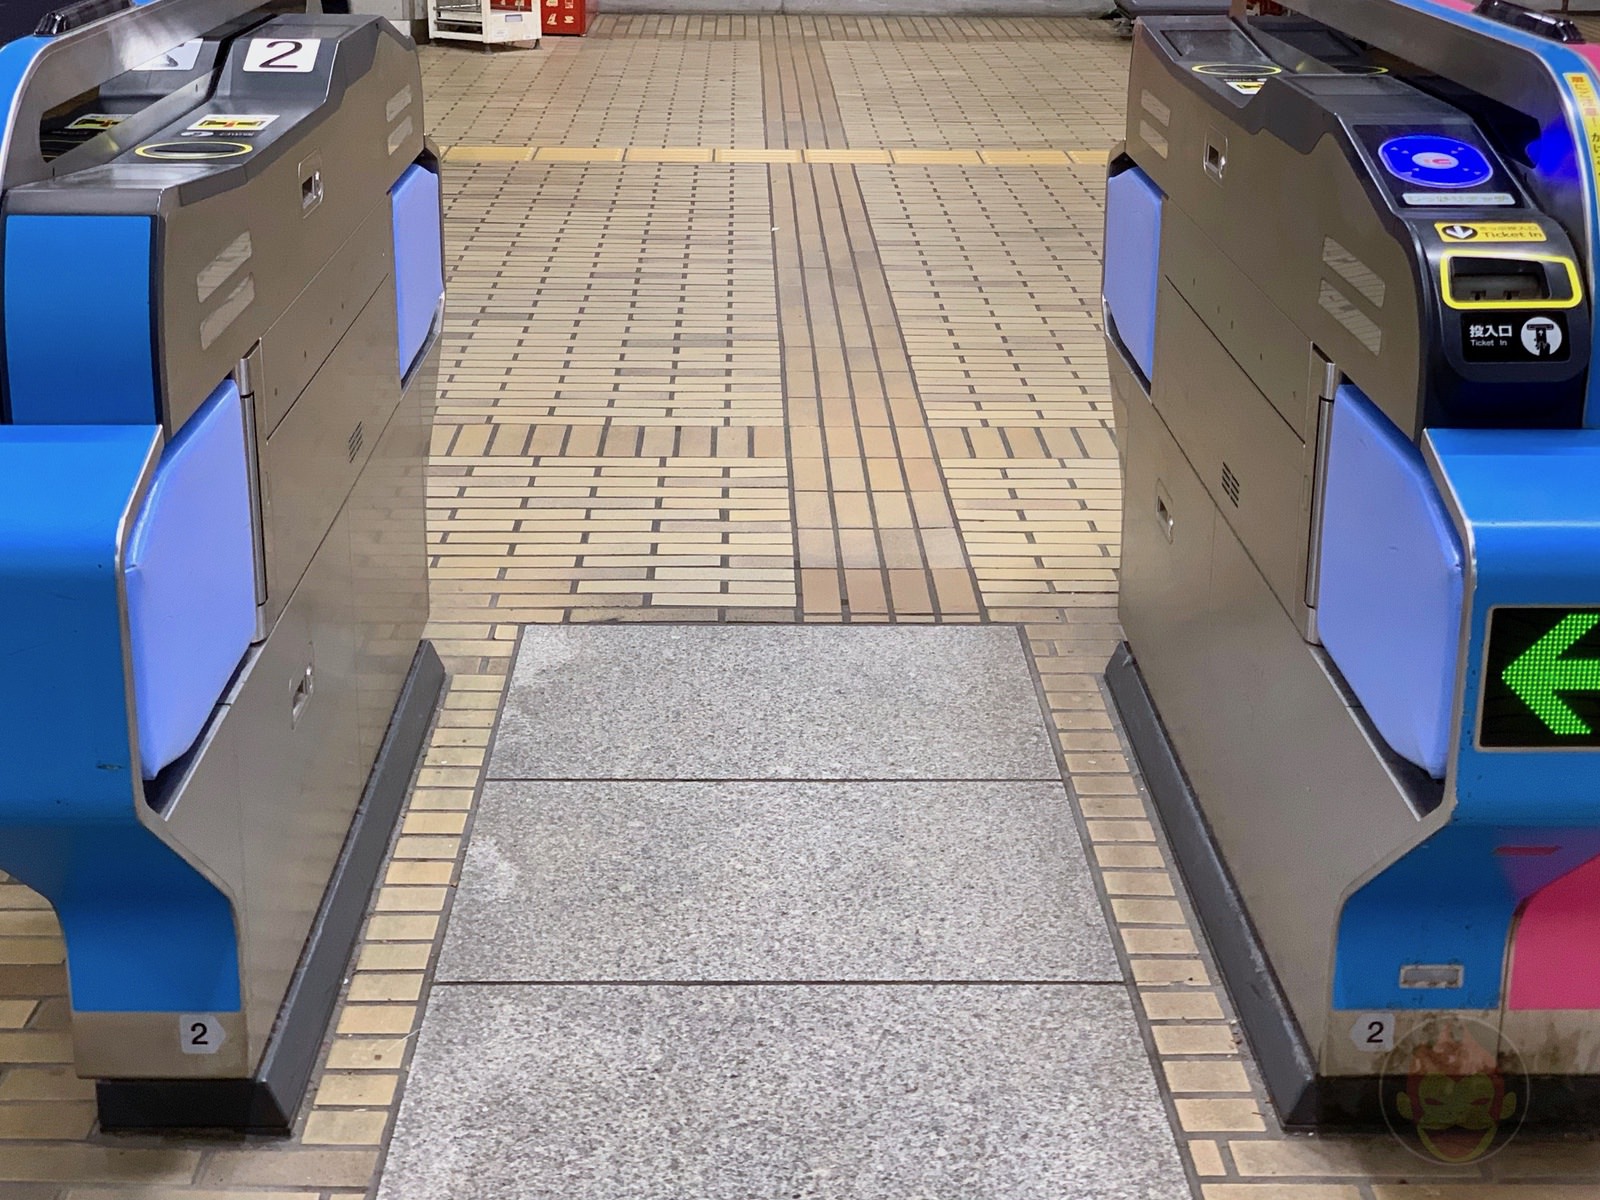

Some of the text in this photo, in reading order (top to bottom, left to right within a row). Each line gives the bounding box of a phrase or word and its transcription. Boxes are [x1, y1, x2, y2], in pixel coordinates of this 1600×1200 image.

[259, 40, 302, 68] 2
[1469, 325, 1512, 337] 投入口
[190, 1023, 208, 1045] 2
[1367, 1021, 1384, 1043] 2
